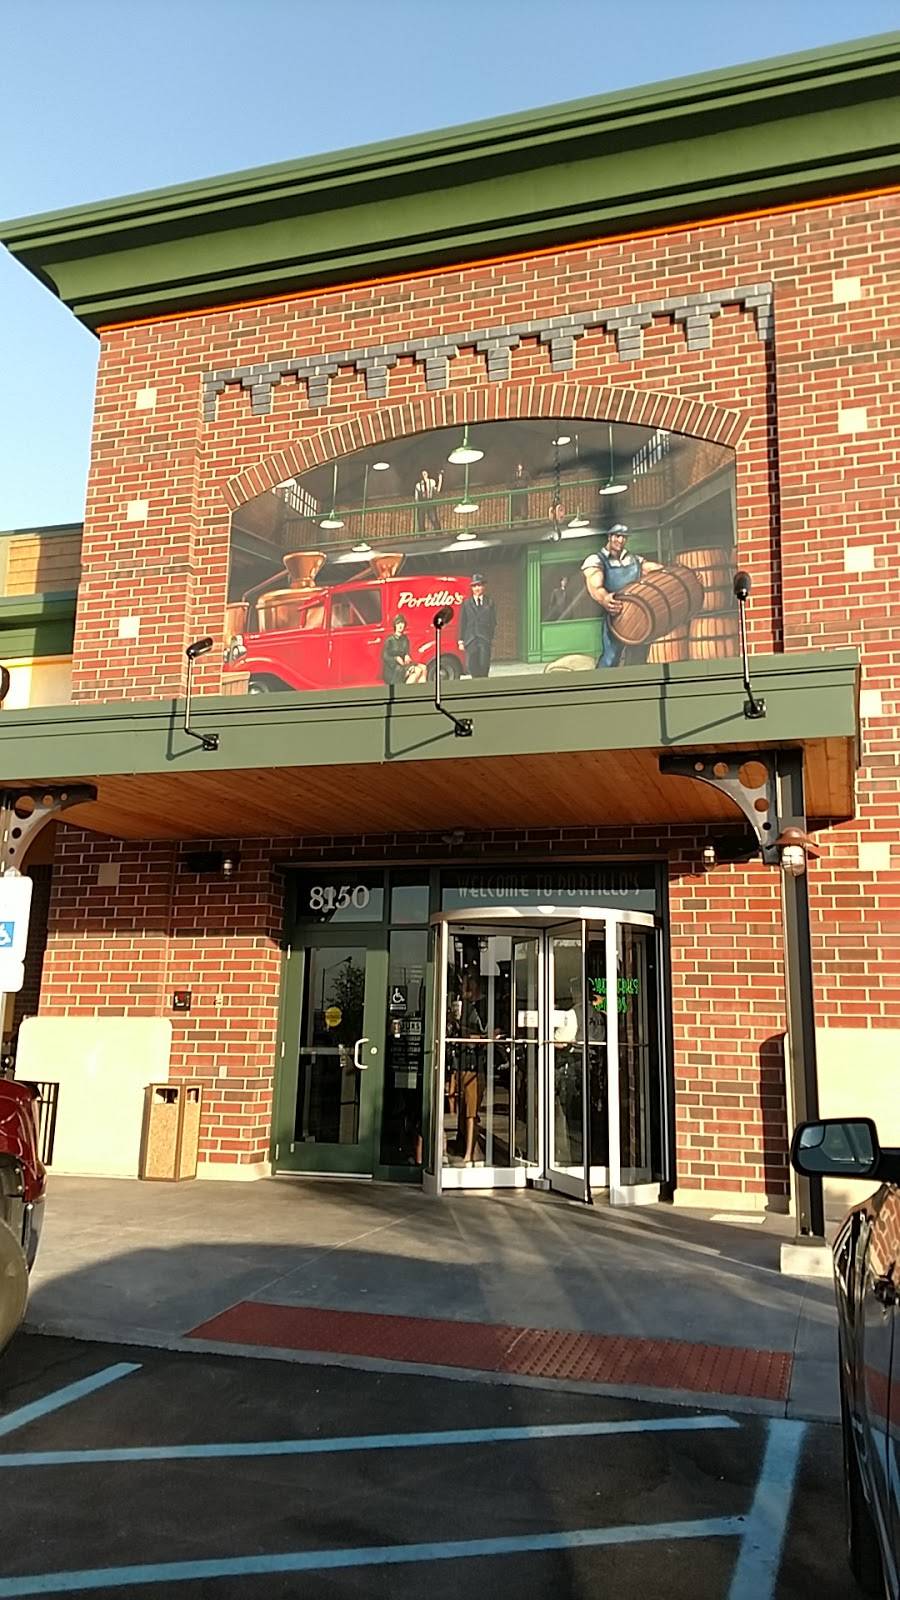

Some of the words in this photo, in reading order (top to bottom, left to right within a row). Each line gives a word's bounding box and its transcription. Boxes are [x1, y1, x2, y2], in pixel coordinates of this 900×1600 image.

[397, 590, 464, 609] Portillo's
[457, 871, 529, 898] WELCOME
[536, 871, 551, 897] TO
[558, 871, 641, 897] PORTILLO'S
[309, 885, 370, 910] 8150
